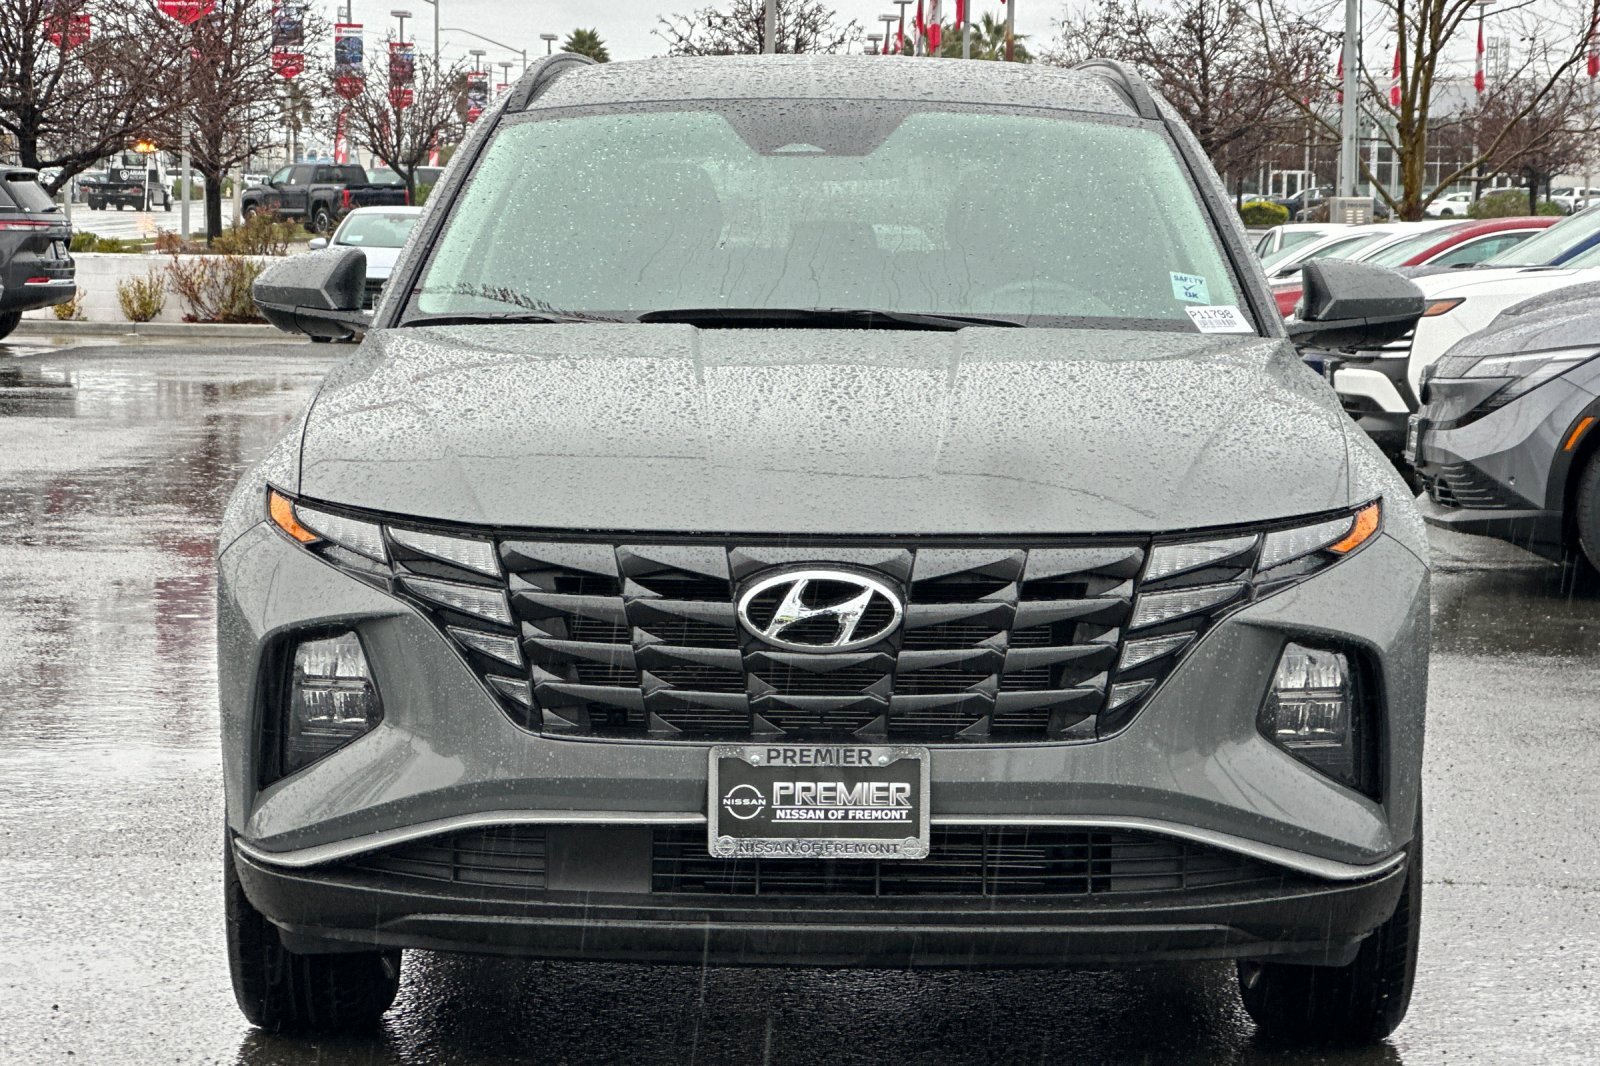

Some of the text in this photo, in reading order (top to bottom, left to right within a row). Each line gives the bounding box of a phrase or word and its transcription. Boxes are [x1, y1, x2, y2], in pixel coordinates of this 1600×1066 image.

[1173, 275, 1203, 284] SAFETY
[1185, 291, 1199, 299] OK
[1189, 309, 1234, 319] P11798
[766, 748, 872, 765] PREMIER
[773, 782, 911, 806] PREMIER
[723, 798, 766, 806] NISSAN
[776, 809, 909, 820] NISSAN OF FREMONT
[738, 843, 900, 854] NISSAN OF FREMONT
